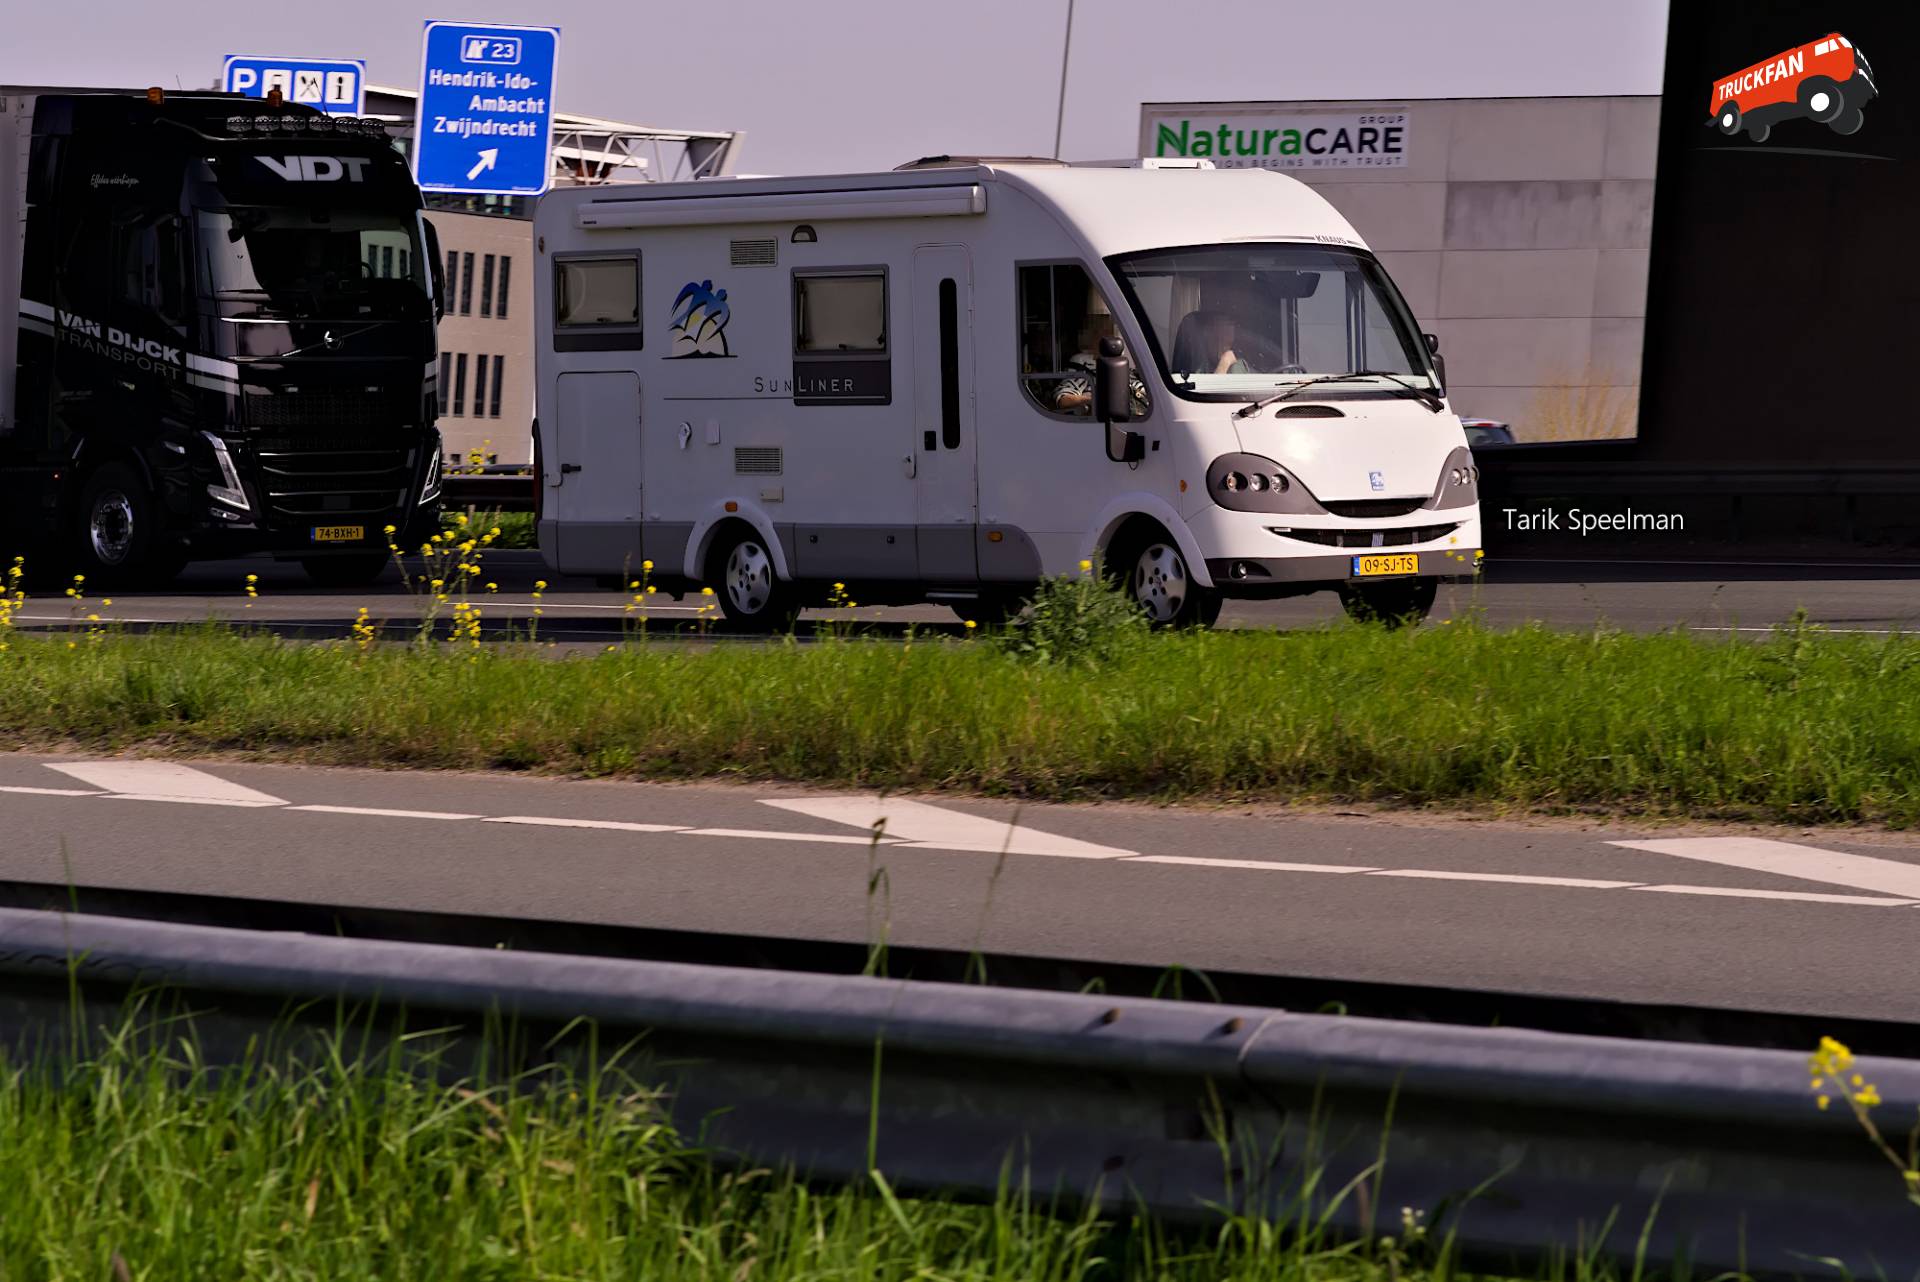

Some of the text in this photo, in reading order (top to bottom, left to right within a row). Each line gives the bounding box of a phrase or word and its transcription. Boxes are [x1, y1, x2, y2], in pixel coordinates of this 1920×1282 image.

[491, 43, 515, 58] 23
[232, 68, 257, 93] P
[428, 69, 538, 90] Hendrik-Ido-
[469, 95, 545, 113] Ambacht
[433, 116, 537, 139] Zwijndrecht
[1359, 116, 1404, 125] GROUP
[1156, 120, 1404, 157] NaturaCARE
[254, 156, 371, 182] VDT
[1252, 159, 1304, 168] BEGINS
[1312, 158, 1347, 167] WITH
[1357, 157, 1401, 166] TRUST
[59, 309, 181, 365] VAN DIJCK
[58, 328, 181, 380] TRANSPORT
[319, 527, 359, 539] 74-BXH-1
[1364, 557, 1413, 572] 09-SJ-TS
